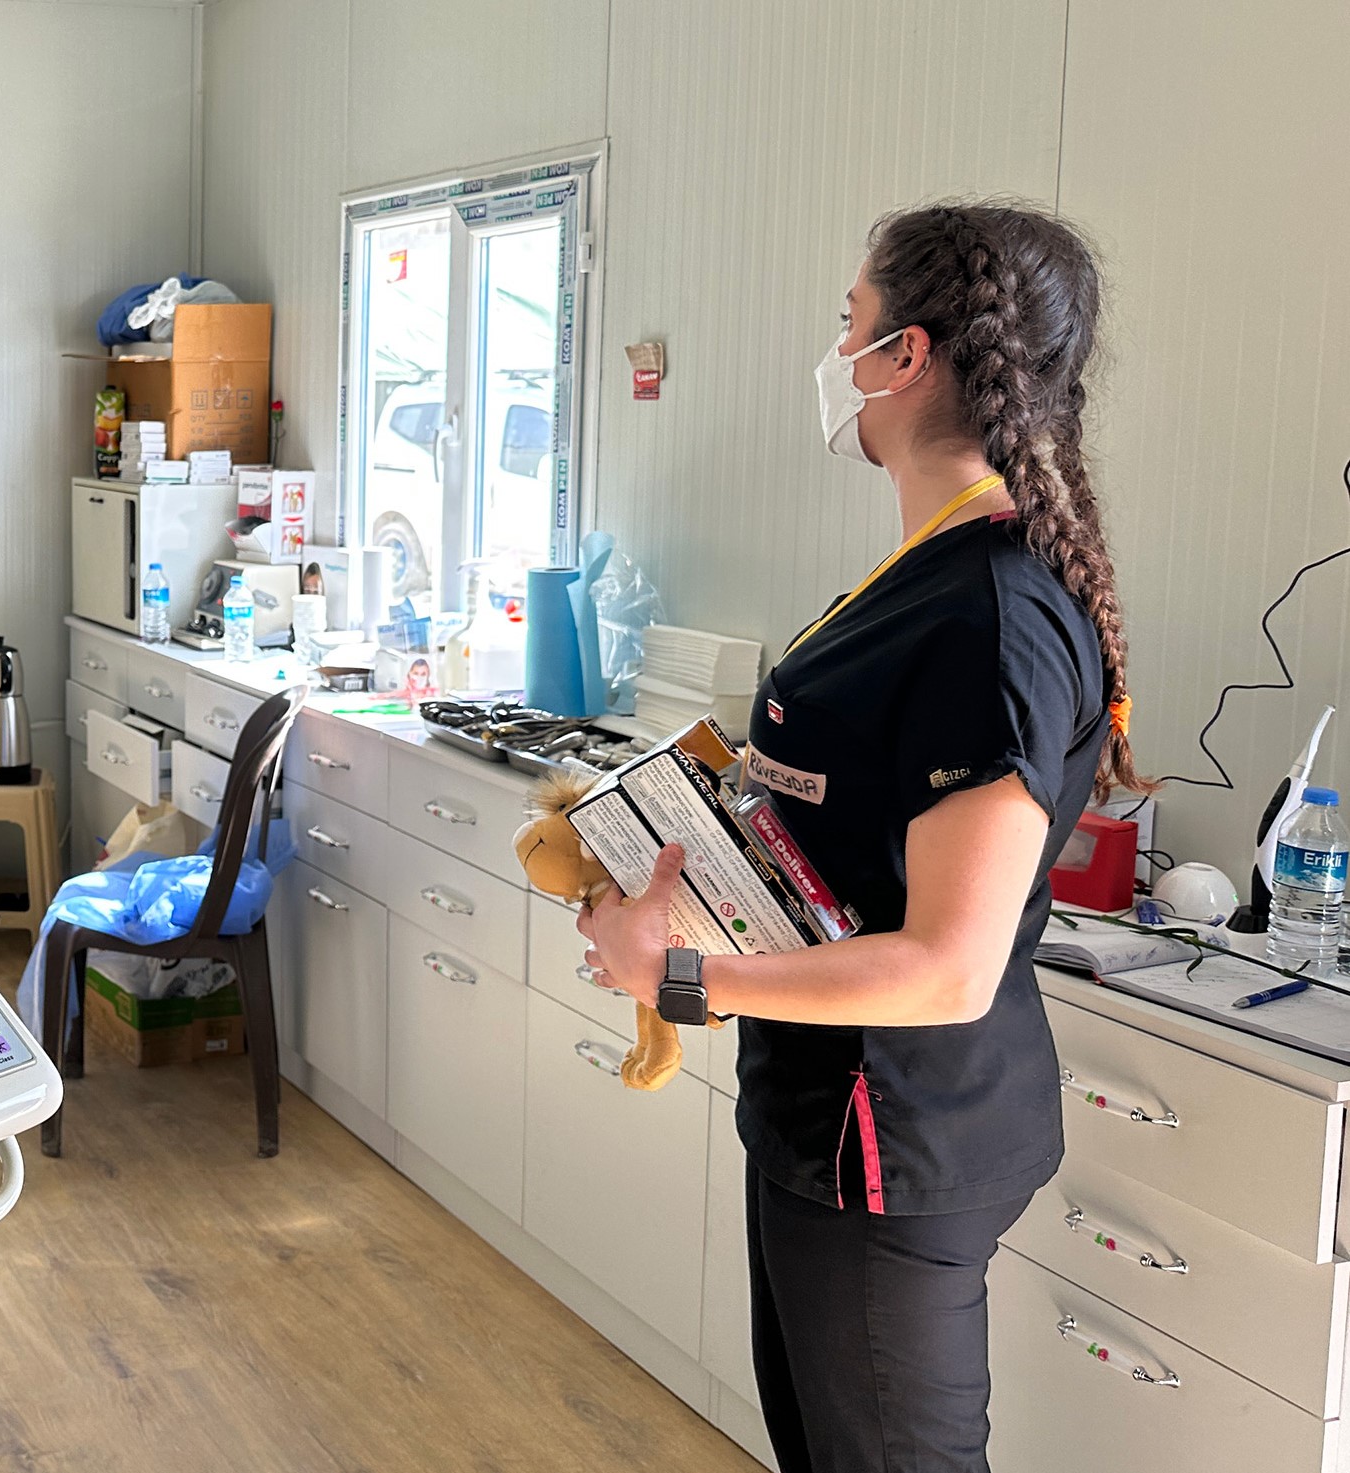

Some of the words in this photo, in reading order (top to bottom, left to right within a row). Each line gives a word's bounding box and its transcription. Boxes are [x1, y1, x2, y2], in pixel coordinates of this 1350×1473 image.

[564, 294, 573, 328] PEN
[562, 327, 572, 365] KOM
[558, 460, 568, 493] PEN
[557, 493, 567, 528] KOM
[669, 745, 696, 777] MAX
[692, 773, 720, 809] METAL
[753, 812, 778, 842] We
[772, 836, 819, 897] Deliver
[1303, 851, 1343, 868] Erikli
